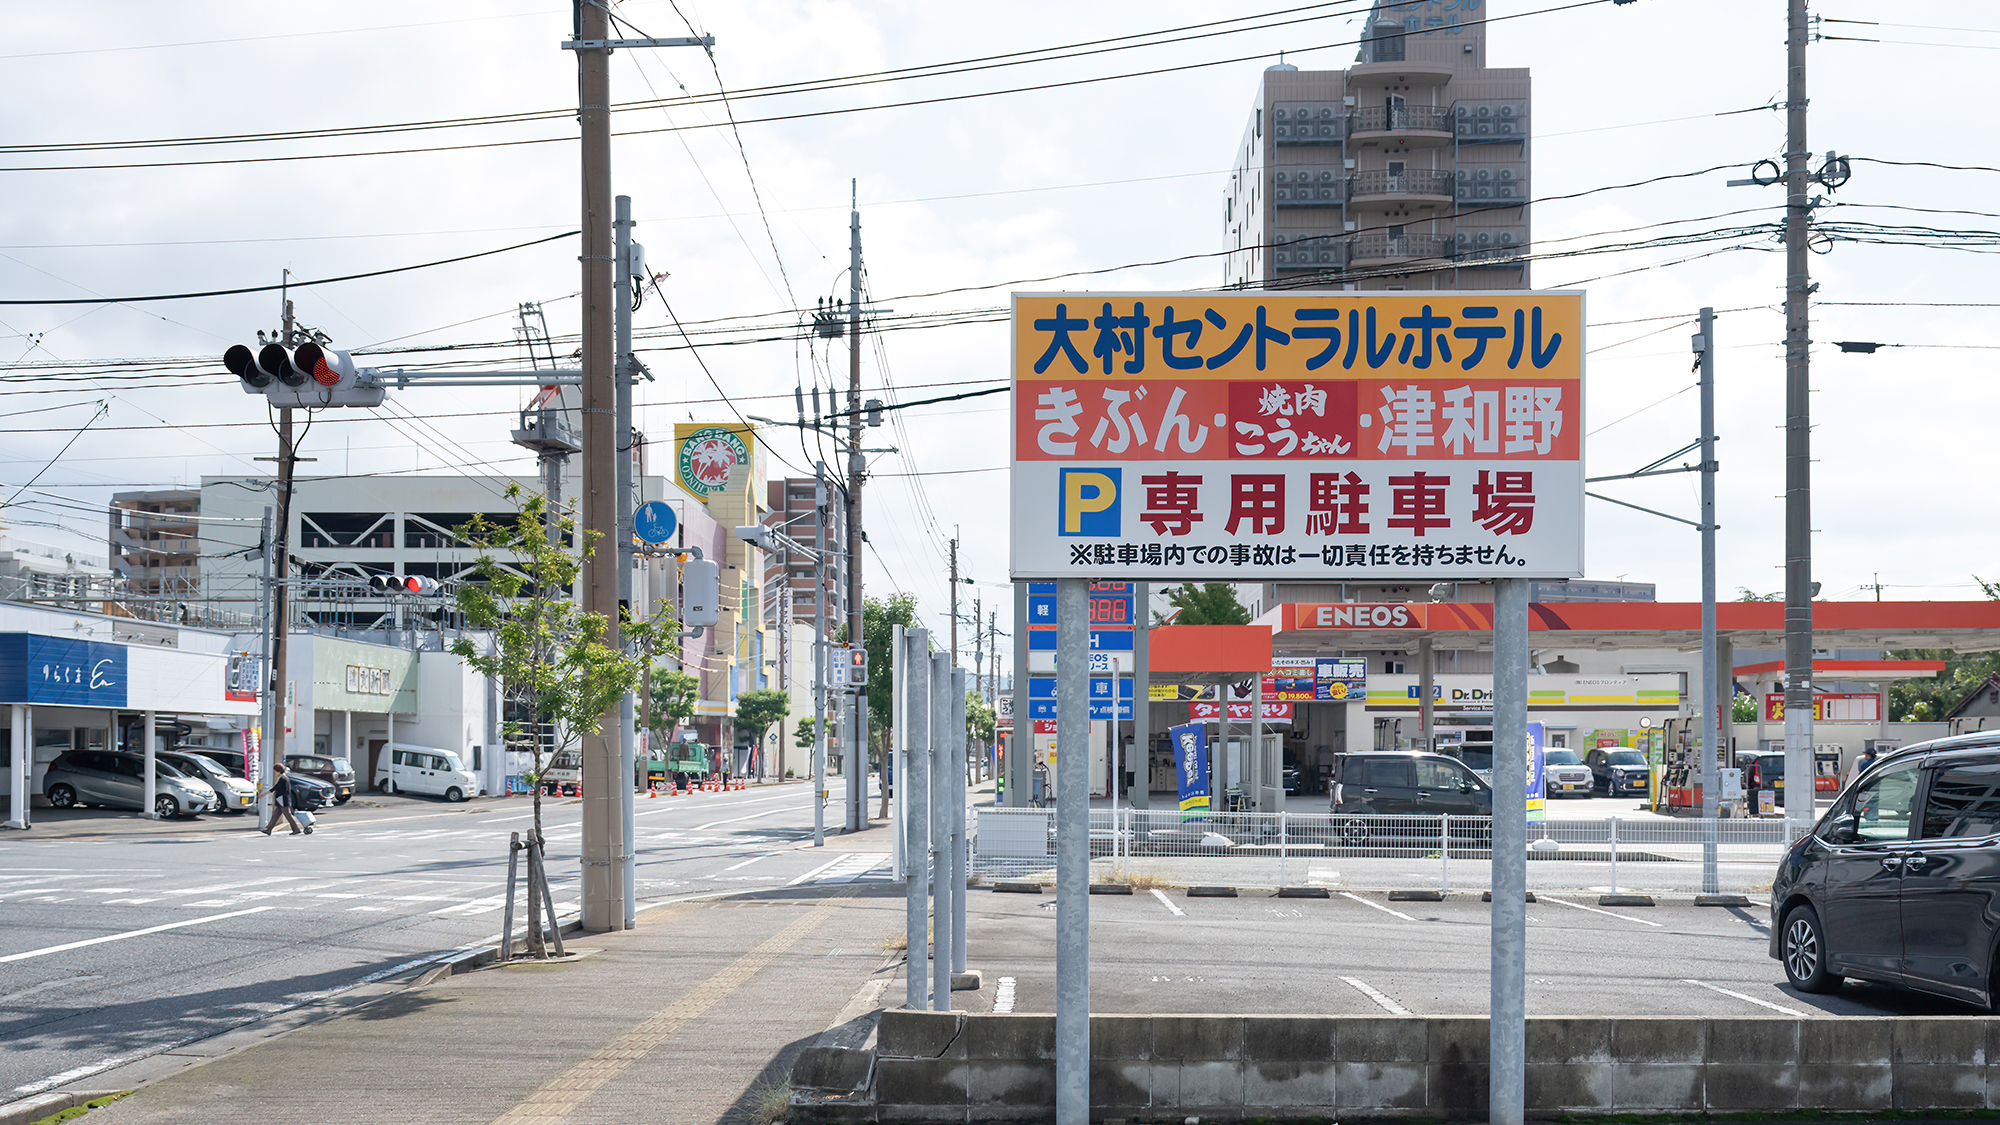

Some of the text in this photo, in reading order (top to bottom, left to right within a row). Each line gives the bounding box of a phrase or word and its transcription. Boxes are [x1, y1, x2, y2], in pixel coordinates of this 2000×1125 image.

[1033, 302, 1562, 375] 大村セントラルホテル
[1259, 384, 1327, 416] 焼肉
[1235, 418, 1352, 456] こうちゃん
[1065, 472, 1115, 533] P
[1140, 470, 1536, 537] 専用駐車場
[1070, 543, 1526, 568] ※駐車場内での事故は一切責任を持ちません。
[1037, 604, 1049, 616] 軽
[1317, 605, 1408, 628] ENEOS
[1089, 654, 1108, 662] EOS
[1090, 663, 1109, 671] リース
[1411, 687, 1416, 697] 1
[1452, 689, 1493, 700] Dr. Dri
